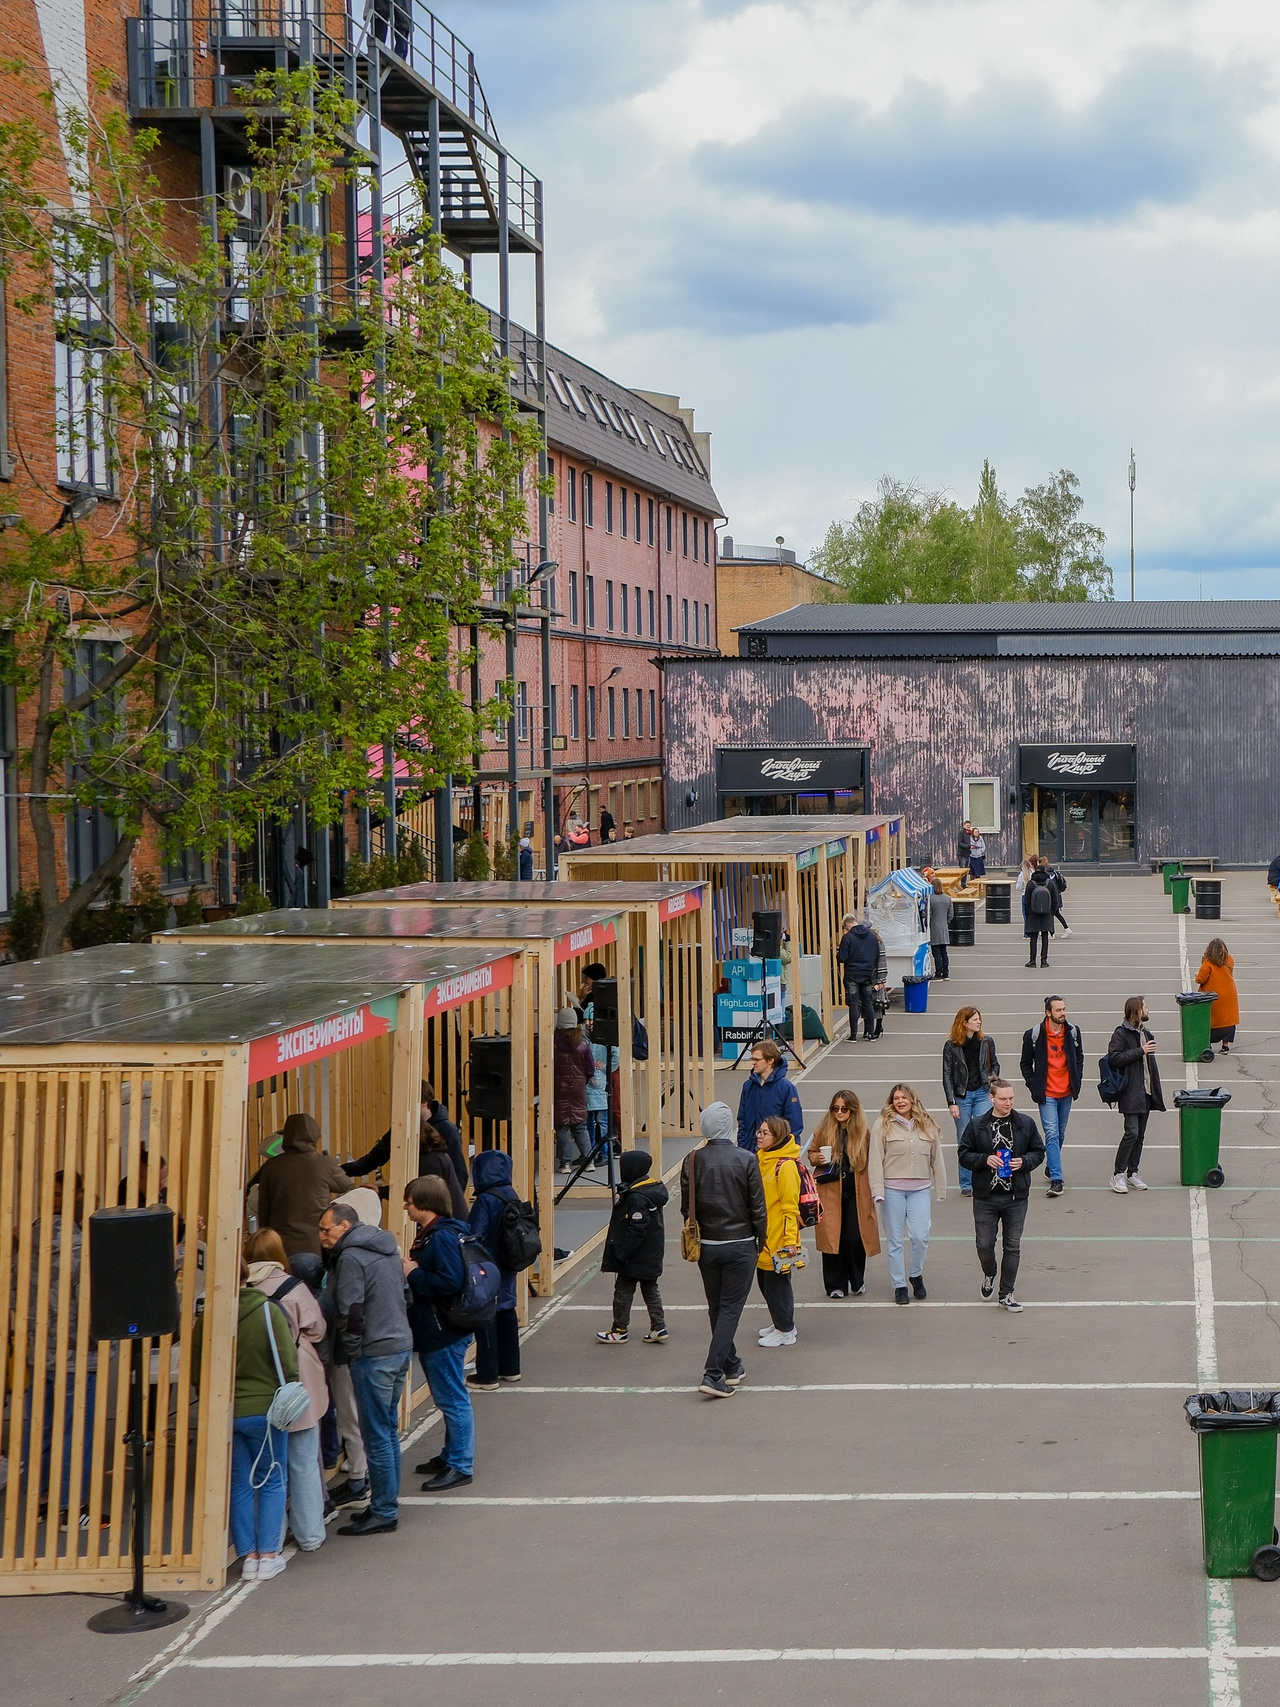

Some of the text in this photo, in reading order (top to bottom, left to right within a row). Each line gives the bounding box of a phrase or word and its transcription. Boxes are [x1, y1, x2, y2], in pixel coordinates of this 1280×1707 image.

[570, 927, 594, 952] BIODATA
[731, 966, 746, 976] API
[436, 965, 492, 1005] ЭКСПЕРИМЕНТЫ
[720, 999, 759, 1008] HighLoad
[277, 1009, 364, 1062] ЭКСПЕРИМЕНТЫ
